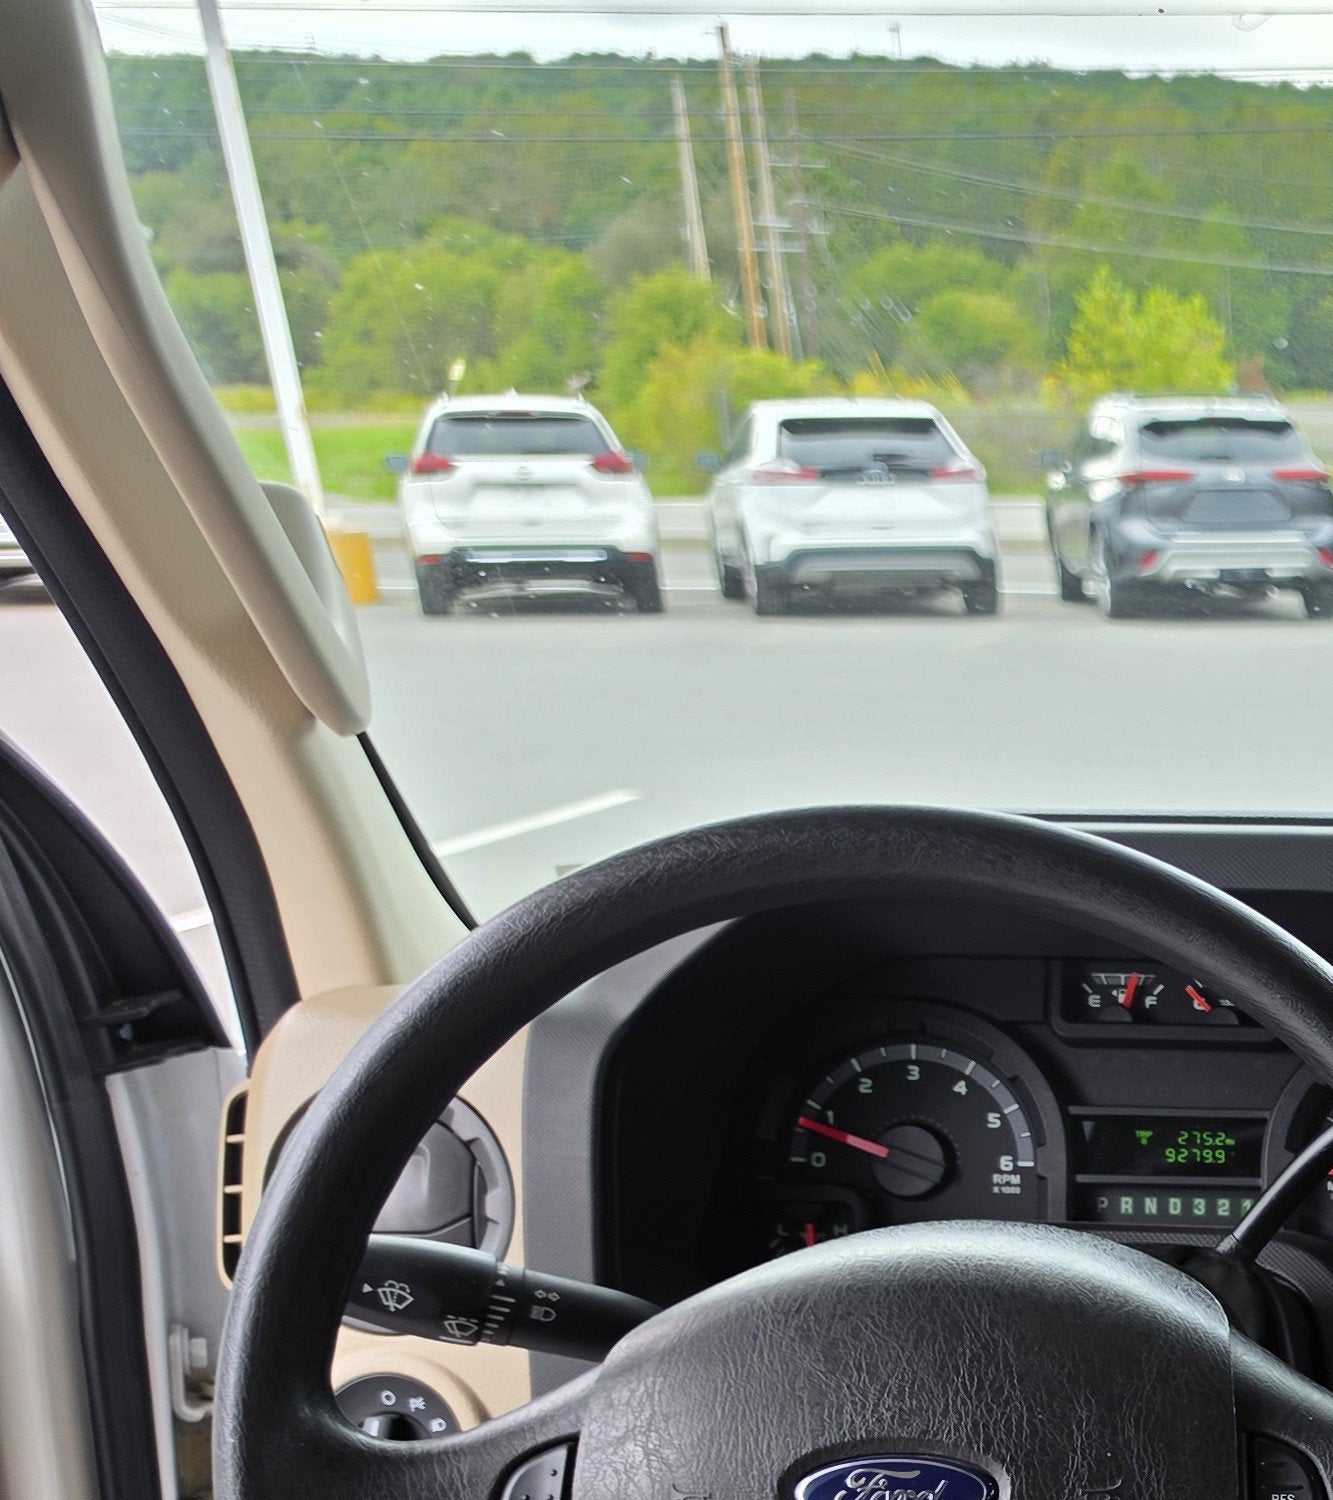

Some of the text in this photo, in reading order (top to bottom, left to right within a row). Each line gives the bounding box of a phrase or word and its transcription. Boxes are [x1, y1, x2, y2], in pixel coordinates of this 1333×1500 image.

[1088, 994, 1101, 1008] E
[1145, 995, 1158, 1009] F
[906, 1065, 920, 1081] 3
[858, 1077, 873, 1094] 2
[953, 1079, 968, 1096] 4
[826, 1110, 835, 1124] 1
[986, 1112, 1002, 1129] 5
[811, 1151, 826, 1168] 0
[999, 1155, 1014, 1172] 6
[992, 1173, 1021, 1185] RPM
[1099, 1196, 1254, 1216] P R N D 3 2 1
